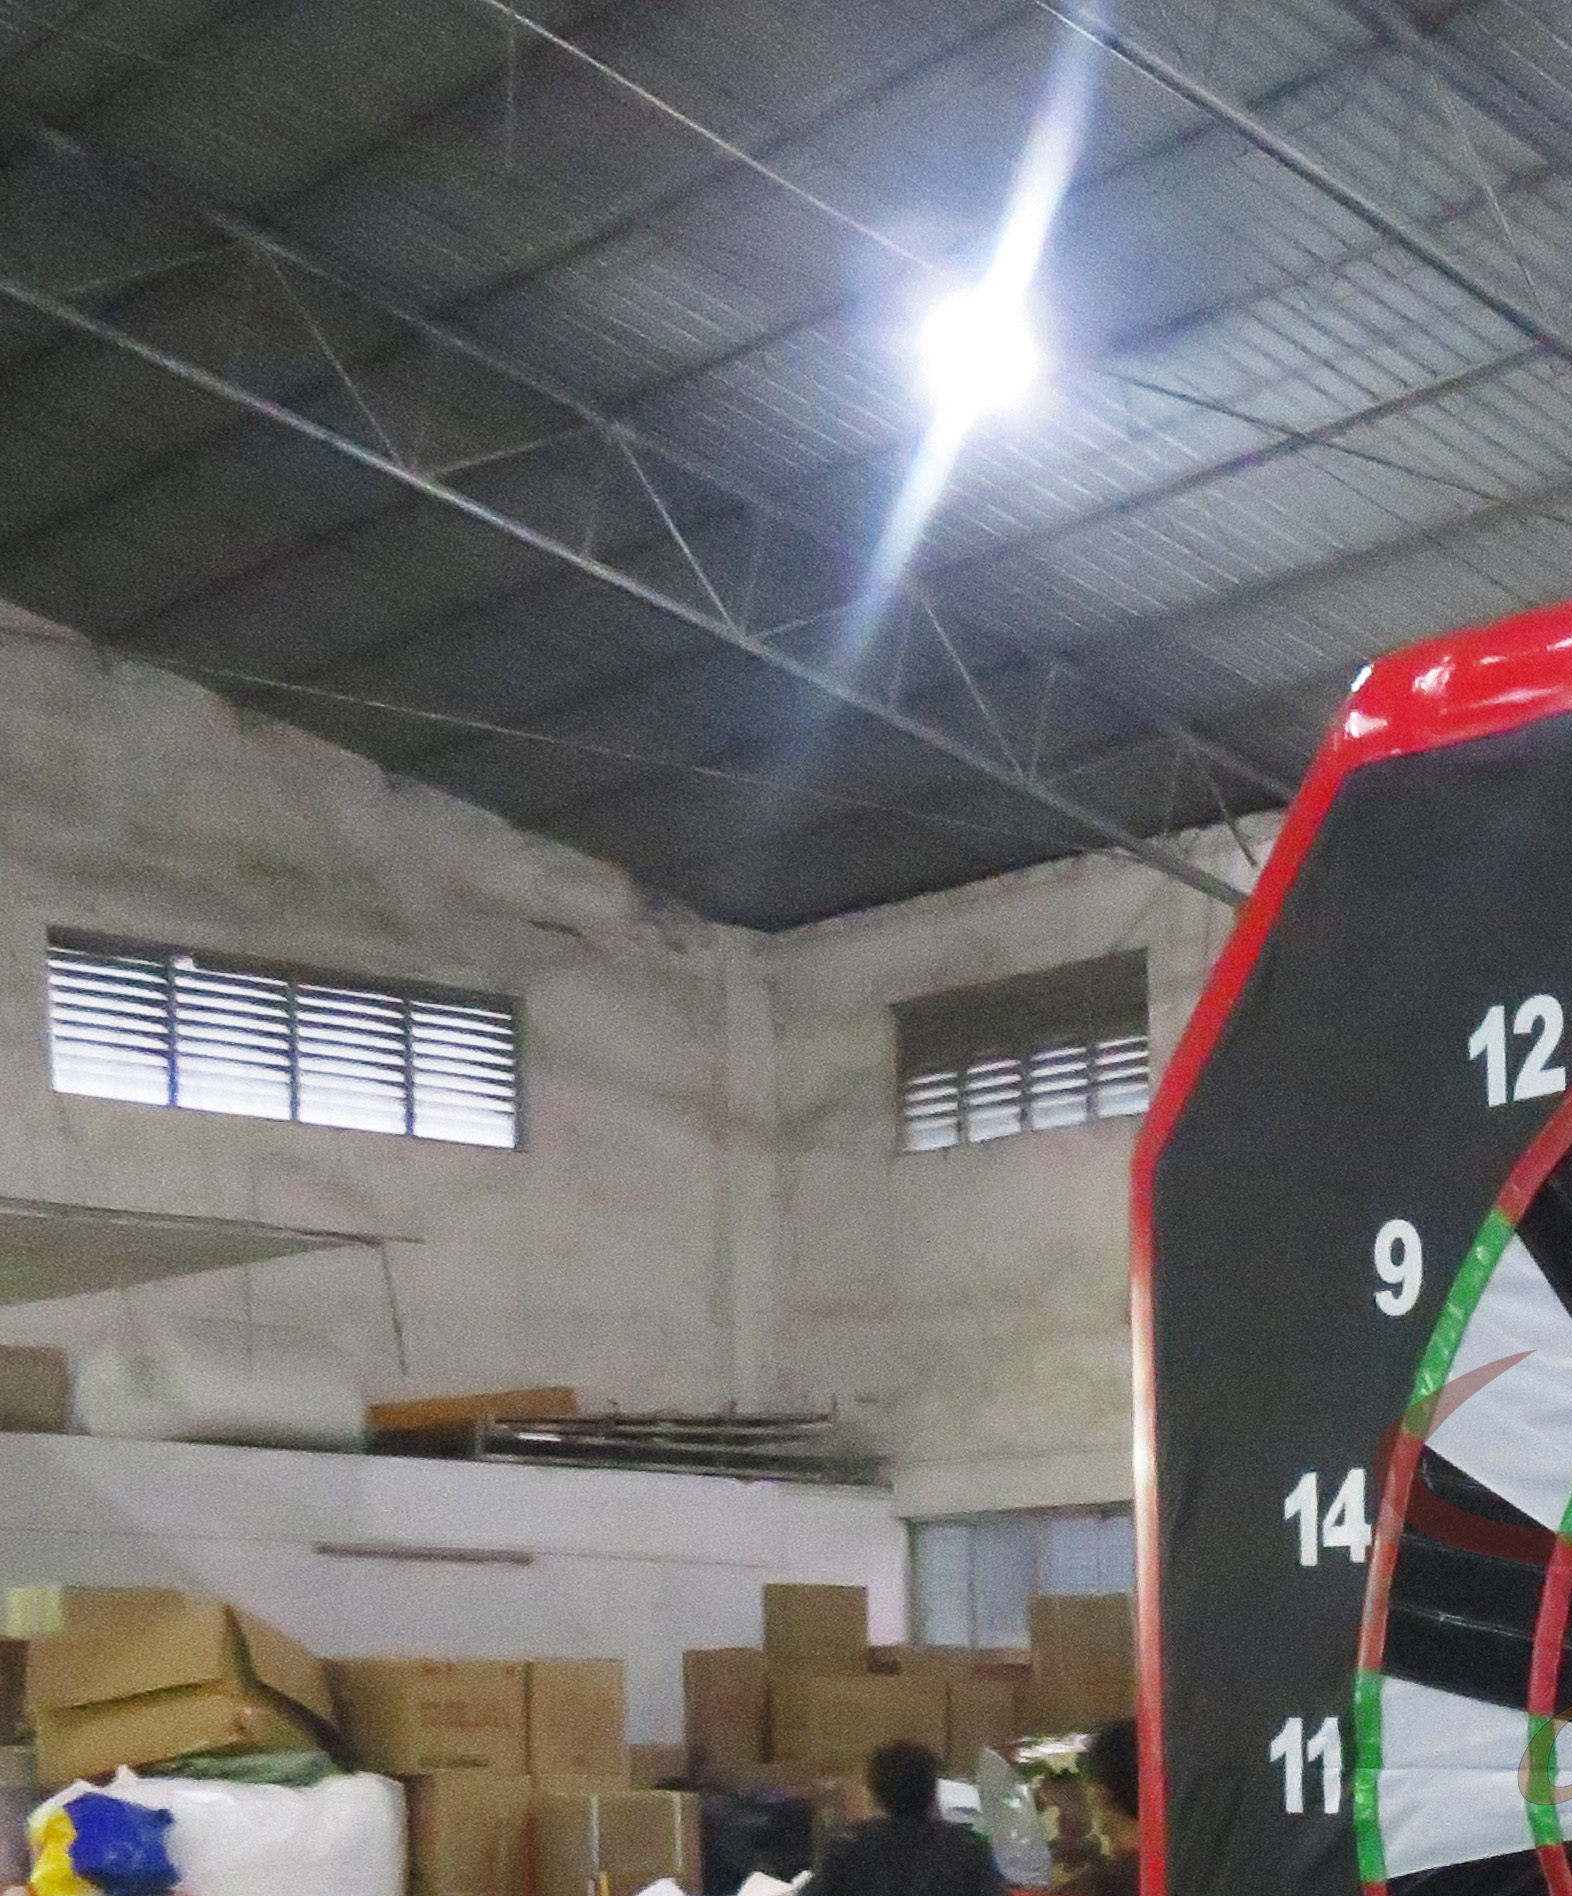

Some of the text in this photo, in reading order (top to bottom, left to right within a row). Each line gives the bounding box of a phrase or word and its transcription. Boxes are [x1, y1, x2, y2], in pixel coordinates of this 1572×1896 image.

[1468, 994, 1566, 1107] 12
[1374, 1219, 1423, 1316] 9
[1285, 1468, 1371, 1567] 14
[1270, 1717, 1342, 1814] 11
